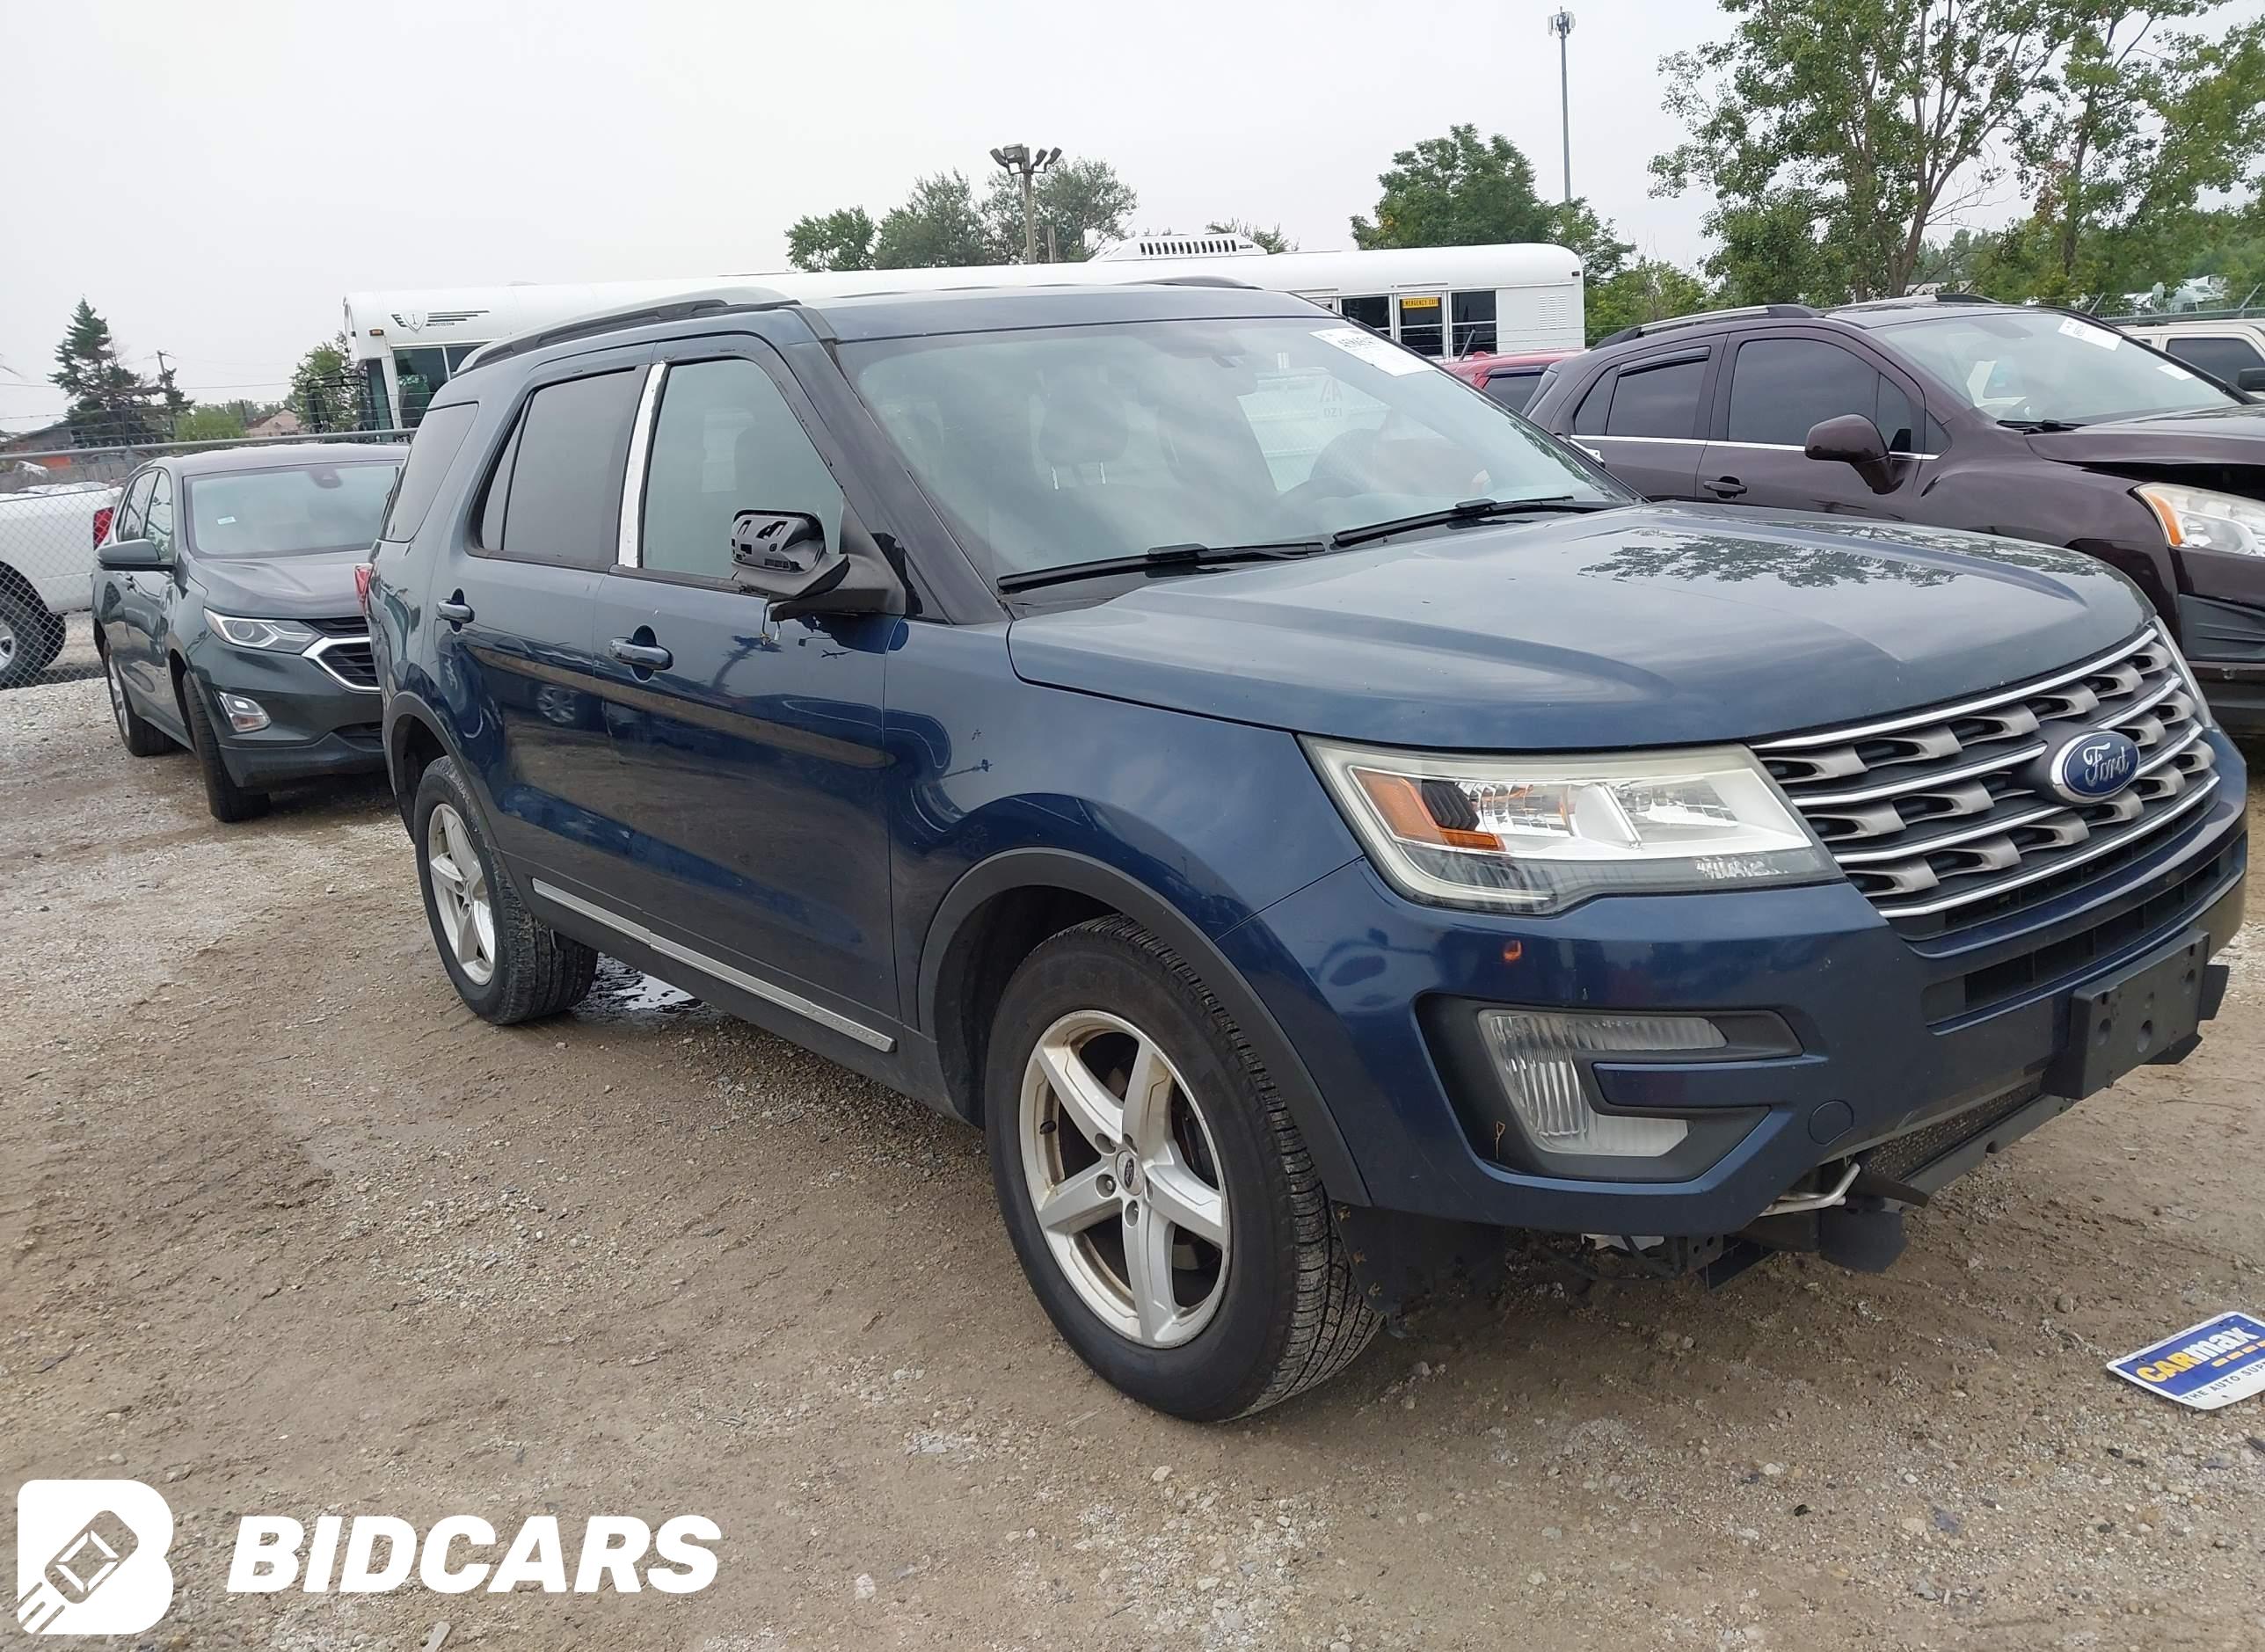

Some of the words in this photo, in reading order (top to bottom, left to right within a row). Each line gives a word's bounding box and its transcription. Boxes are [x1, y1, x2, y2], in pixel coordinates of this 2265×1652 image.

[2082, 742, 2130, 787] Ford
[2182, 1389, 2209, 1401] THE
[2210, 1375, 2240, 1392] AUTO
[2241, 1361, 2265, 1377] SUP
